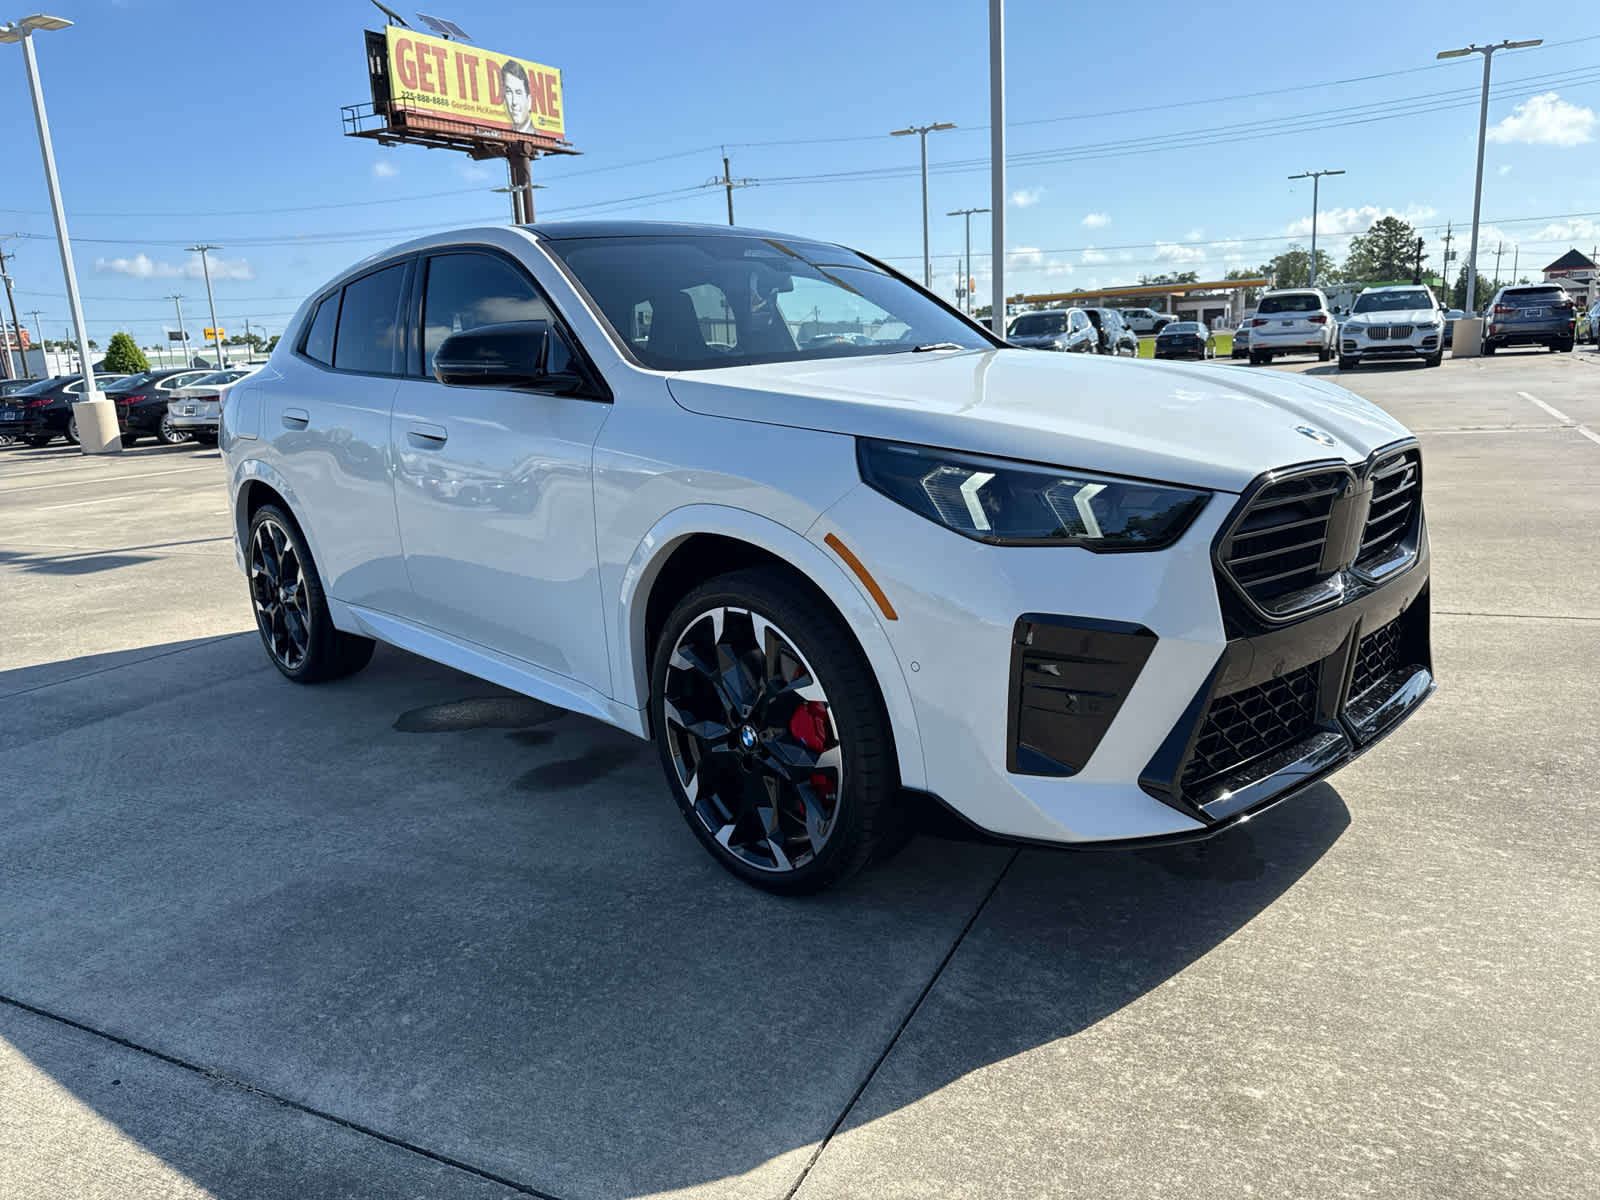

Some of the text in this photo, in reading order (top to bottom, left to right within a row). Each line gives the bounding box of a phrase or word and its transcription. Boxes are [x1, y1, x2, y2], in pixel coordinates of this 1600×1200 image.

[395, 38, 559, 118] GET IT DNE
